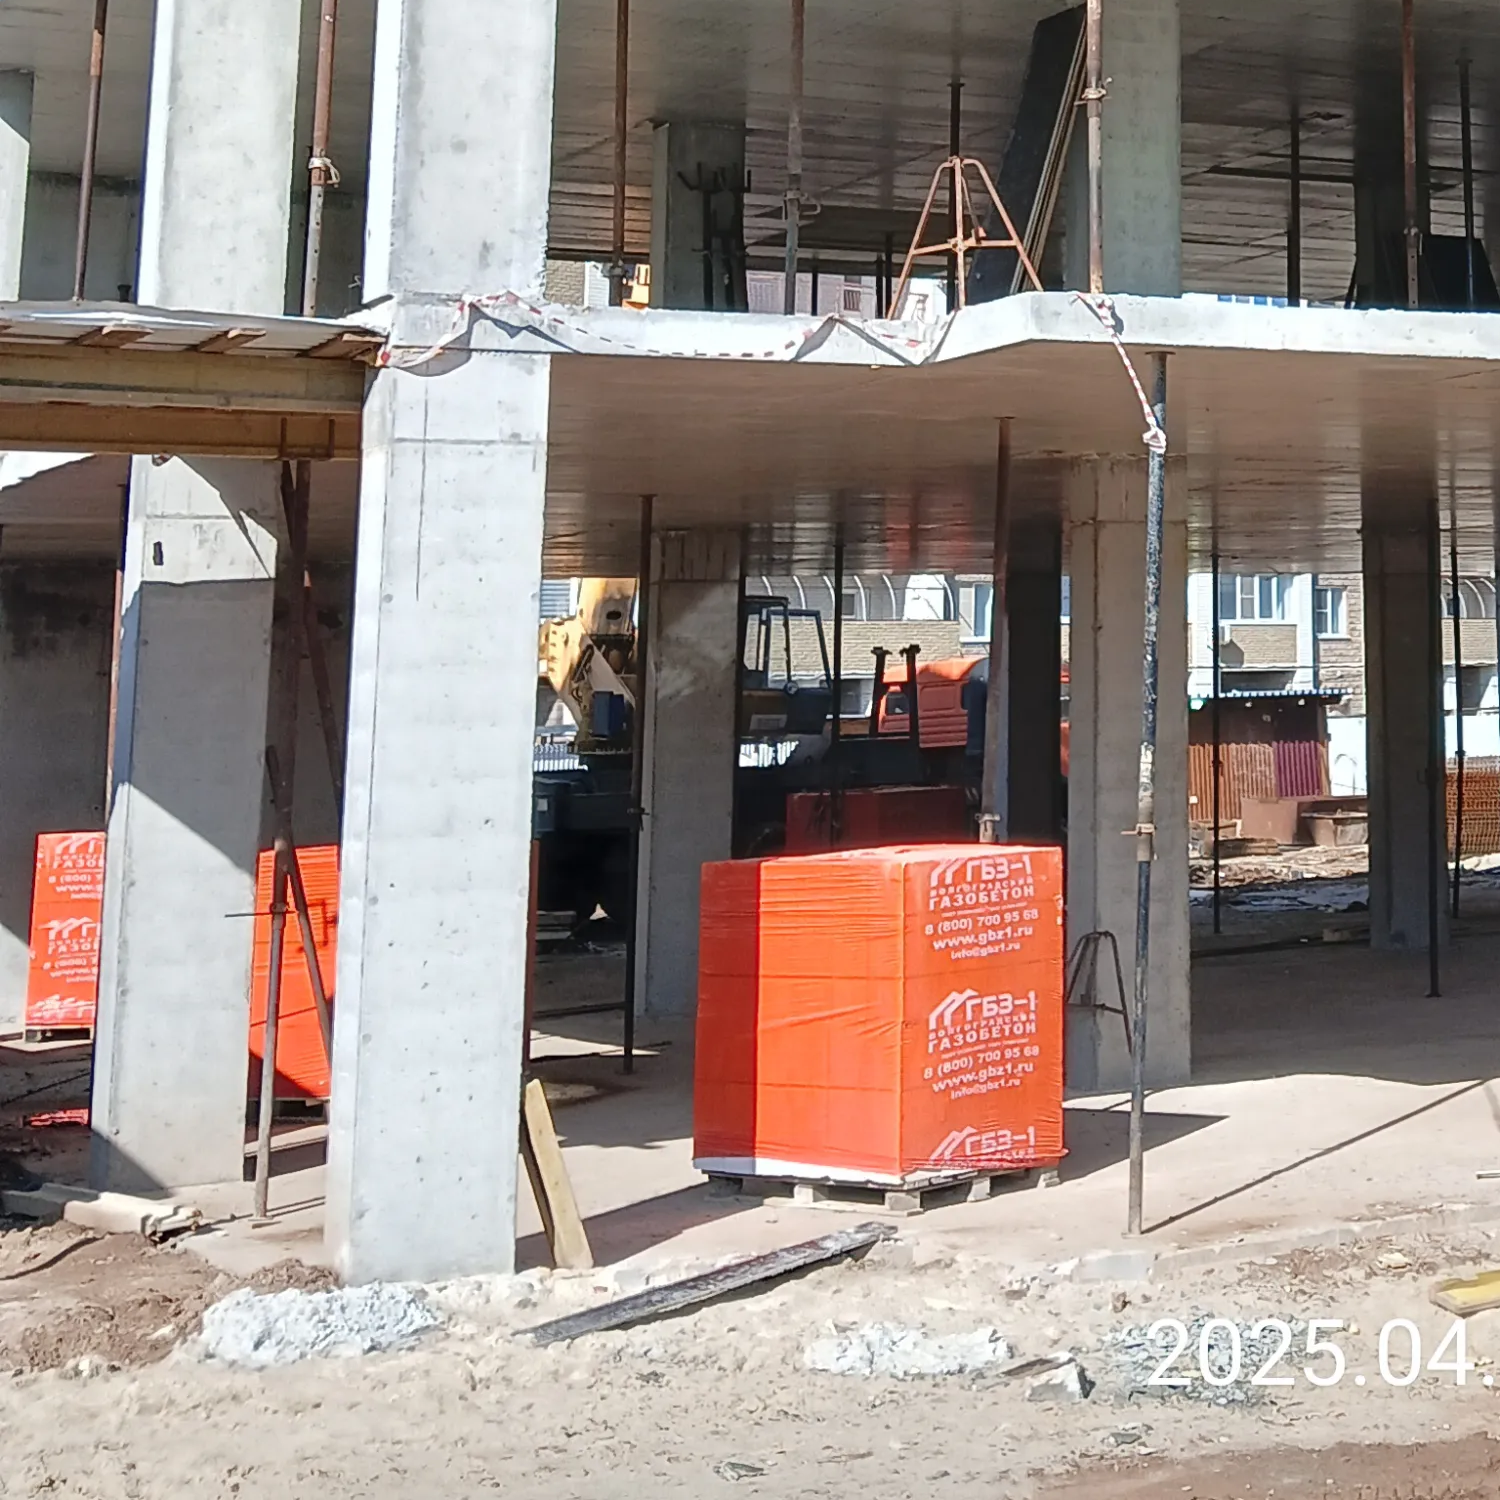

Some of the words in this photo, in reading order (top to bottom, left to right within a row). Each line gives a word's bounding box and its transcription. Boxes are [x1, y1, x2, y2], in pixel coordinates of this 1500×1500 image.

[966, 854, 1033, 882] ГБЗ-1
[928, 885, 1034, 911] ГАЗОБЕТОН
[925, 924, 934, 936] 8
[937, 917, 973, 935] (800)
[976, 913, 1001, 927] 700
[1003, 910, 1020, 923] 95
[1023, 908, 1039, 920] 68
[932, 925, 1033, 950] www.gbz1.ru
[965, 990, 1036, 1021] ГБЗ-1
[927, 1021, 1036, 1054] ГАЗОБЕТОН
[923, 1067, 933, 1080] 8
[937, 1056, 974, 1077] (800)
[976, 1049, 1001, 1064] 700
[1004, 1047, 1021, 1059] 95
[1023, 1045, 1040, 1057] 68
[931, 1062, 1034, 1093] www.gbz1.ru
[965, 1125, 1036, 1156] ГБЗ-1
